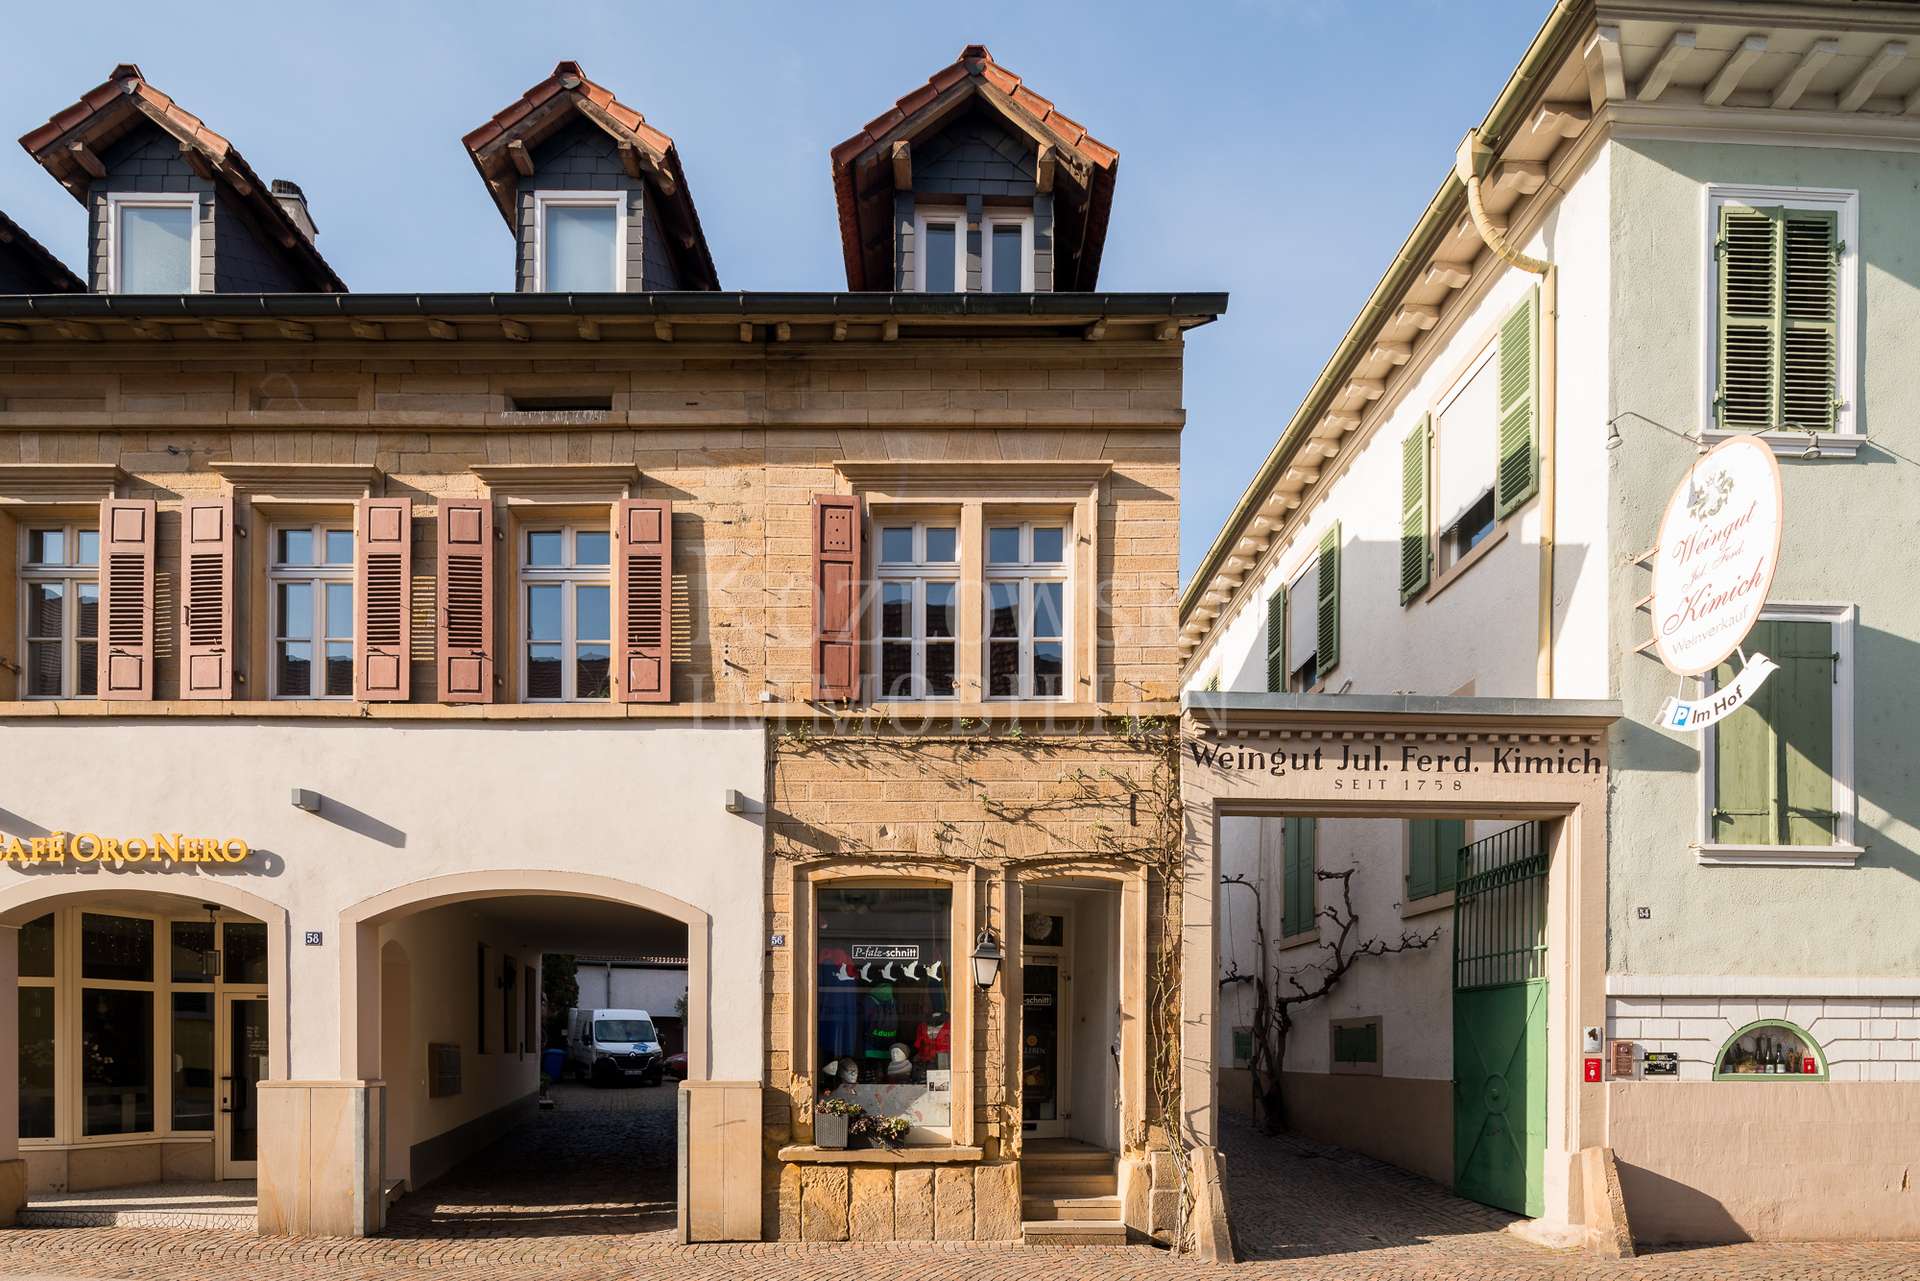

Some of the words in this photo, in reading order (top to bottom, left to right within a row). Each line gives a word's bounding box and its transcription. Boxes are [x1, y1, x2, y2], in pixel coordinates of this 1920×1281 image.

[1671, 499, 1758, 566] Weingut
[1662, 555, 1765, 636] Kimich
[1671, 604, 1750, 656] Weinverkauf
[1691, 708, 1711, 725] Im
[1713, 685, 1744, 716] Hof
[1188, 742, 1323, 776] Weingut
[1337, 744, 1389, 772] Jul.
[1401, 745, 1480, 774] Ferd.
[1493, 747, 1601, 775] Kimich
[1334, 778, 1387, 791] SEIT
[1404, 779, 1463, 792] 1758
[0, 830, 65, 862] AFÉ
[306, 933, 320, 944] 58
[771, 935, 783, 945] 56
